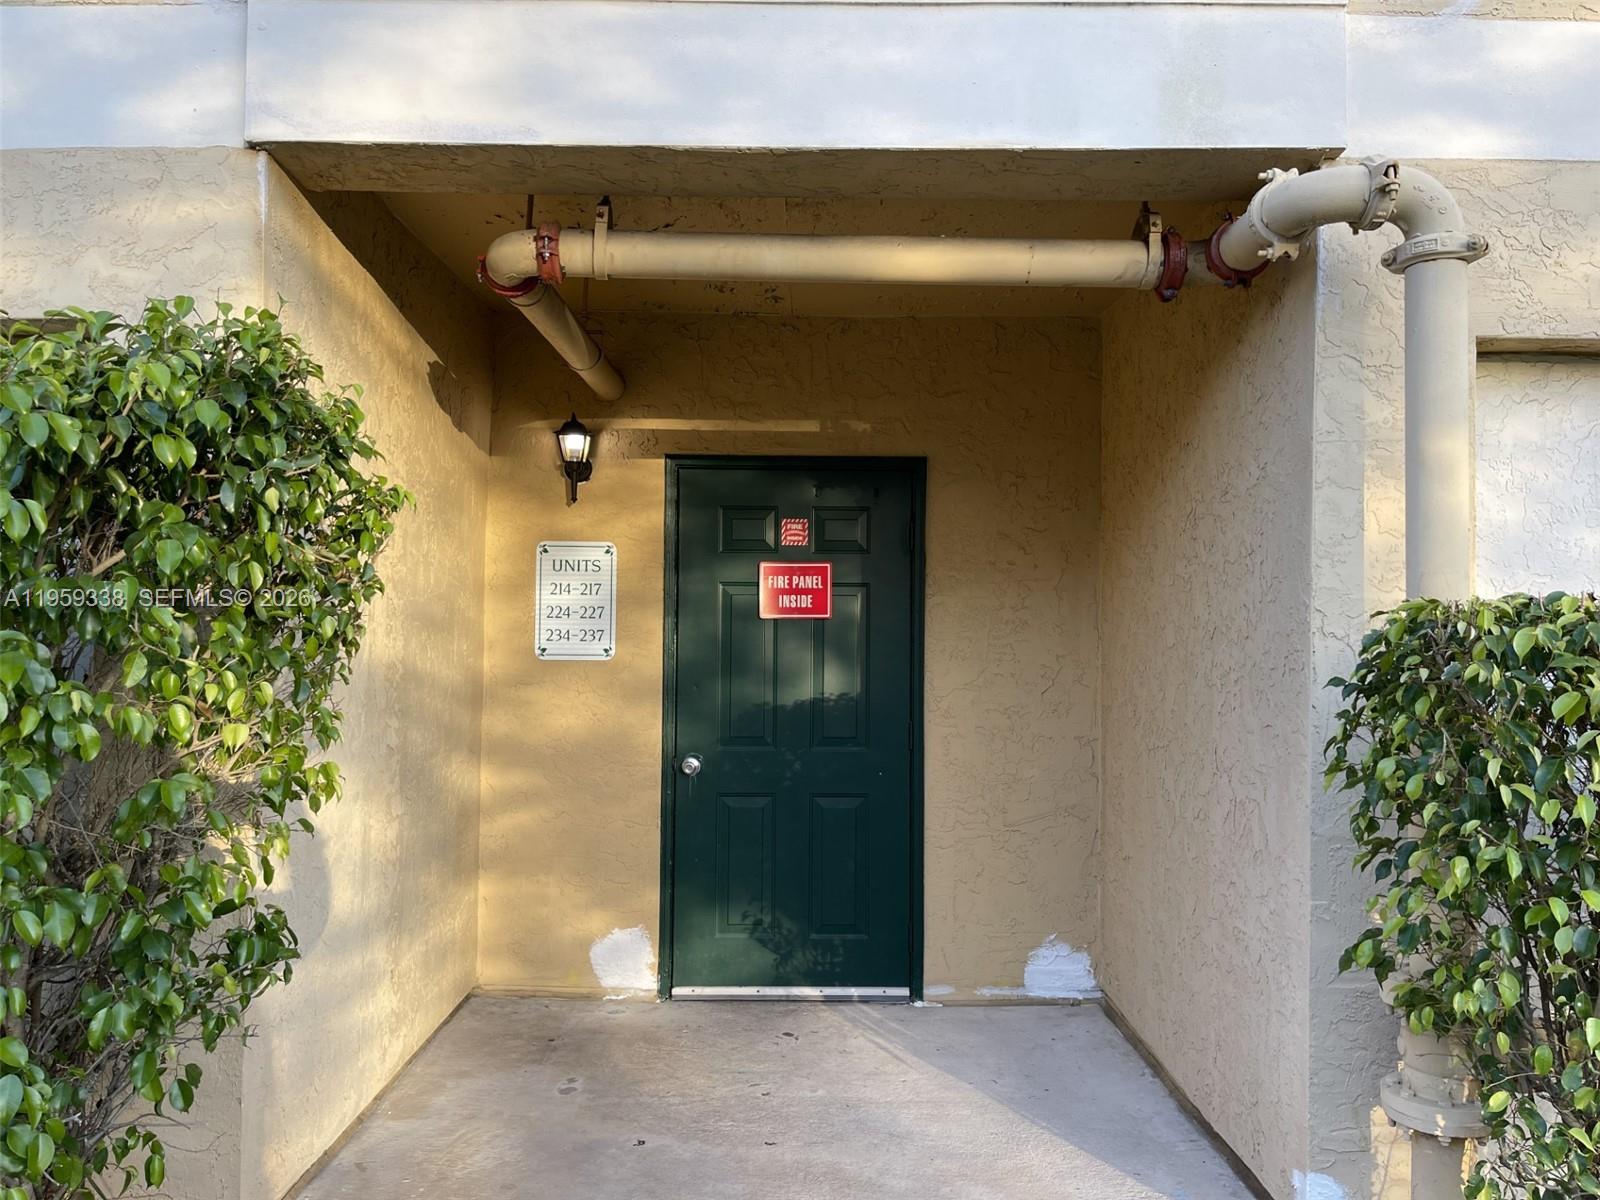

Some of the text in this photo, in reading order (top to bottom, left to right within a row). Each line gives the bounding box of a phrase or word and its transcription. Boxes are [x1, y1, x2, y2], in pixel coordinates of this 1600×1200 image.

[553, 559, 601, 573] UNITS
[768, 576, 823, 589] FIRE PANEL
[550, 583, 602, 596] 214-217
[779, 595, 812, 608] INSIDE
[546, 606, 605, 619] 224-227
[545, 629, 605, 642] 234-237
